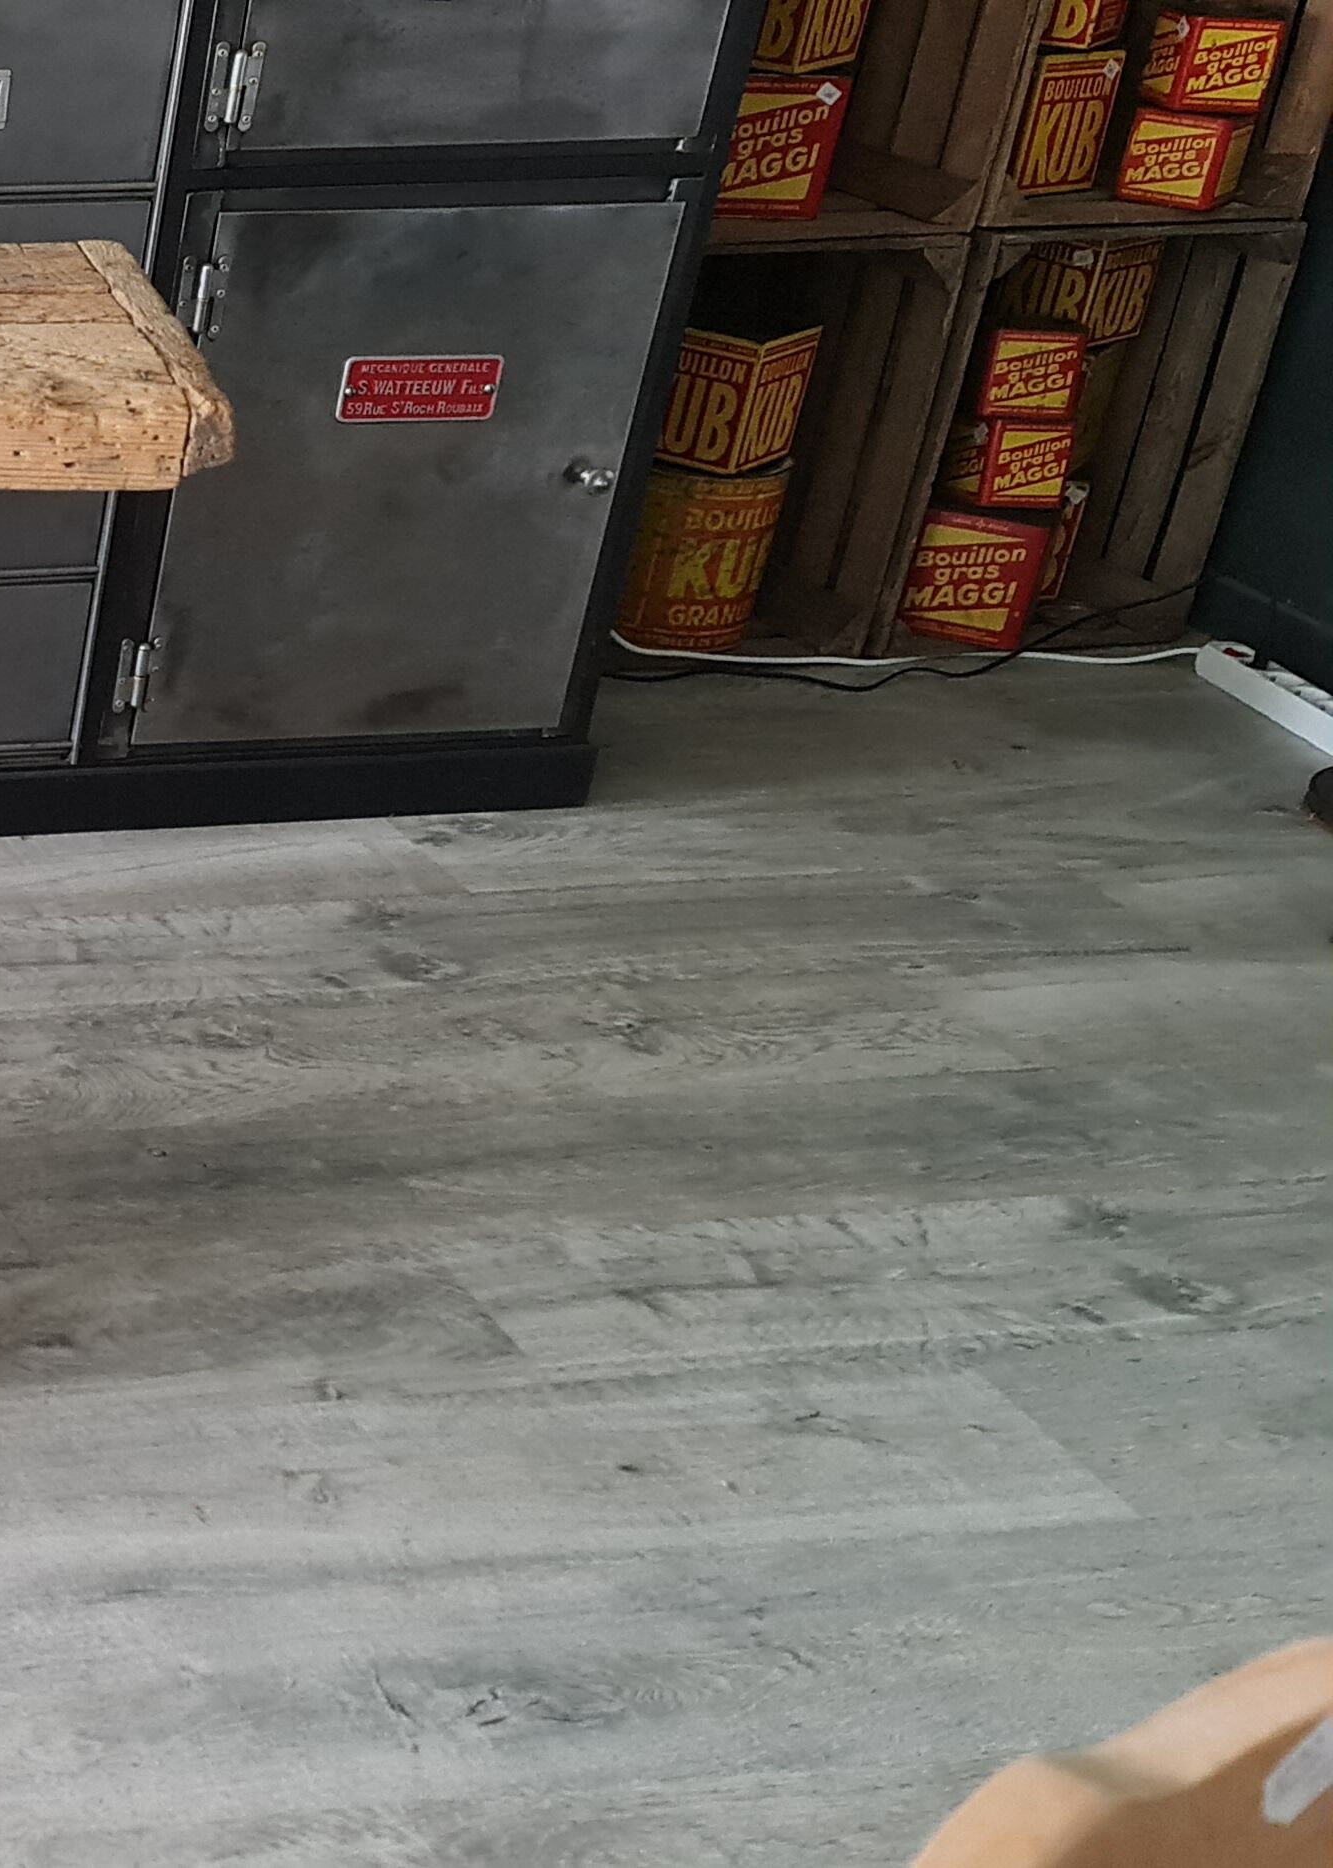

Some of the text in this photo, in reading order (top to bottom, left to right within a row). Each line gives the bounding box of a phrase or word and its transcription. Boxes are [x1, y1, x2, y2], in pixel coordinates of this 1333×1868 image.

[1194, 36, 1277, 64] Bouillon
[1186, 61, 1270, 93] MAGGI
[1206, 53, 1258, 75] gras
[1044, 76, 1114, 102] BOUILLON
[737, 128, 803, 160] gras
[1021, 99, 1104, 186] KUB
[1133, 137, 1217, 156] Bouillon
[1124, 161, 1210, 183] MAGGI
[1143, 149, 1197, 168] gras
[1088, 264, 1153, 340] KUB
[678, 350, 748, 384] UILLON
[994, 350, 1078, 375] Bouillon
[1007, 363, 1060, 384] gras
[990, 370, 1074, 401] MAGGI
[659, 372, 737, 462] UB
[739, 373, 803, 466] KUB
[998, 438, 1067, 465] Bouillon
[1010, 453, 1055, 474] gras
[992, 459, 1068, 491] MAGGI
[916, 546, 1027, 567] Bouillon
[934, 564, 1001, 586] gras
[904, 581, 1019, 609] MAGGI
